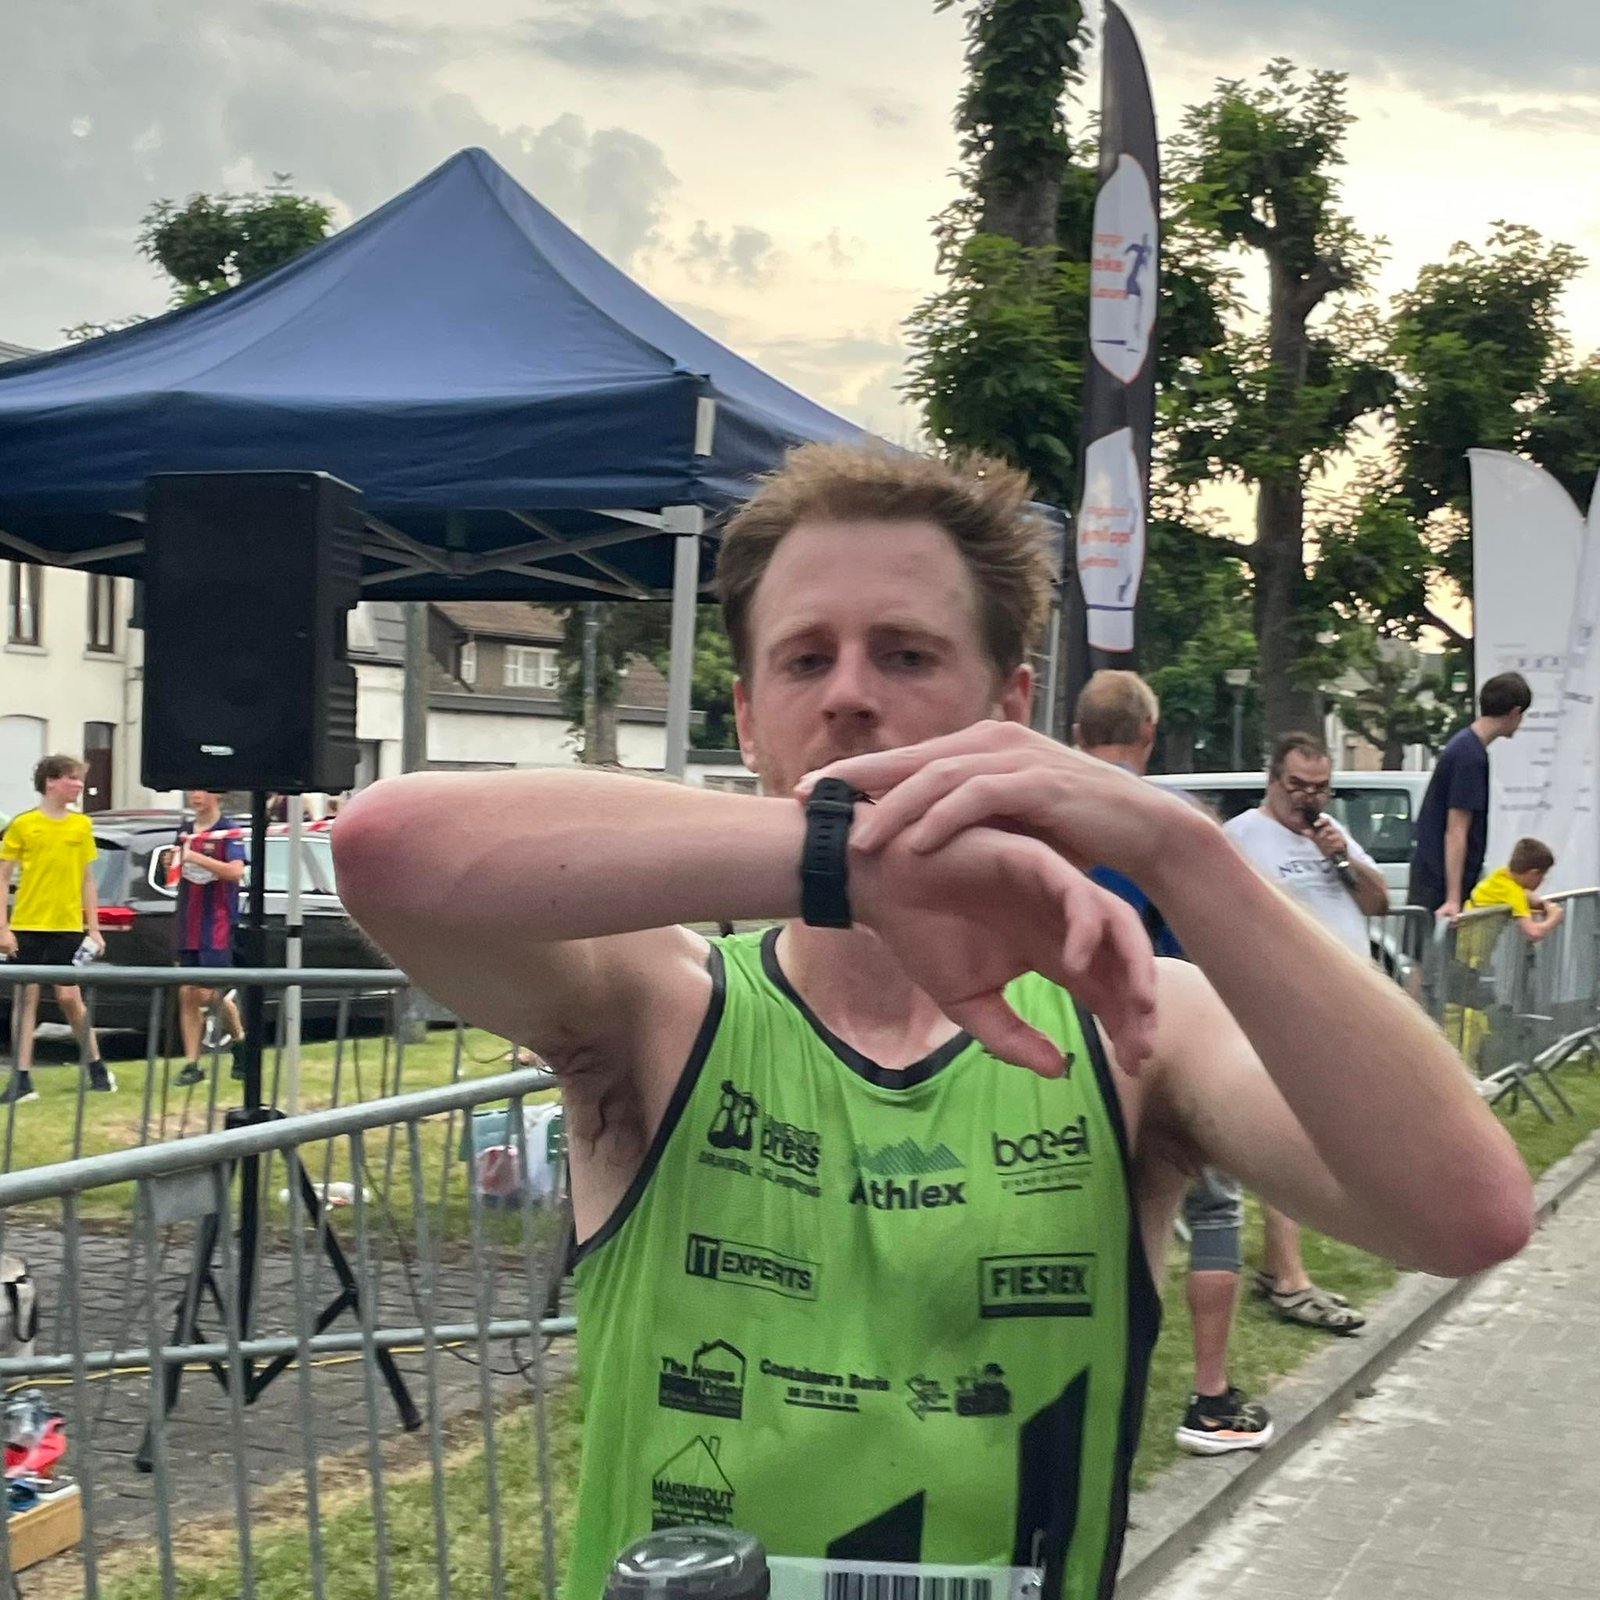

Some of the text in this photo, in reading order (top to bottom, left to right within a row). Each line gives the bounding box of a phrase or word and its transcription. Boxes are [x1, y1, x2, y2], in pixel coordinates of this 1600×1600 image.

[849, 1175, 967, 1210] Athlex
[687, 1237, 813, 1291] IT EXPERTS
[661, 1356, 688, 1377] The
